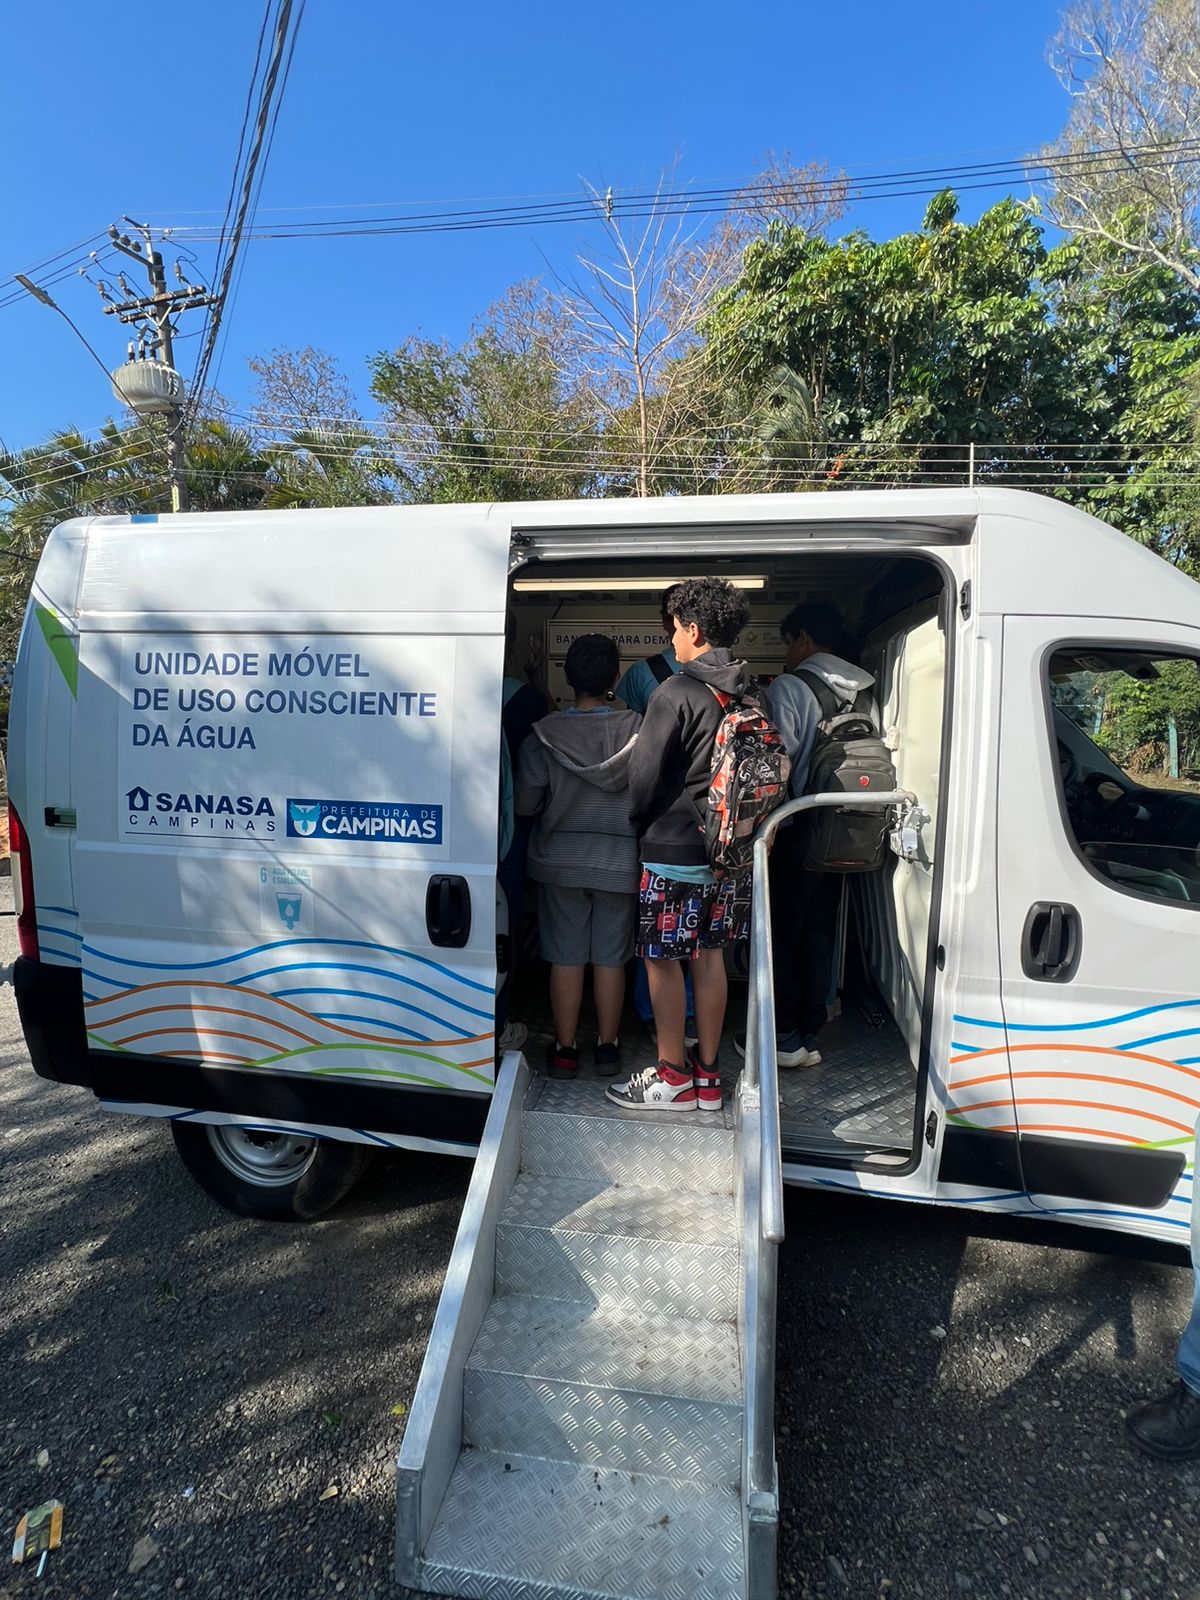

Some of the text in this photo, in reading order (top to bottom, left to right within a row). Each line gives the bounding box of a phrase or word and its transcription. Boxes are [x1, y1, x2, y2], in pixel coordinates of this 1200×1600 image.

[612, 635, 641, 645] PARA
[135, 646, 370, 677] UNIDADE MÓVEL
[133, 688, 437, 717] DE USO CONSCIENTE
[132, 718, 256, 750] DA ÁGUA
[156, 793, 276, 817] SANASA
[321, 805, 437, 820] PREFEITURA DE
[129, 814, 276, 832] CAMPINAS
[321, 815, 437, 840] CAMPINAS
[260, 867, 268, 883] 6
[662, 913, 699, 928] FIG
[661, 927, 686, 943] ER
